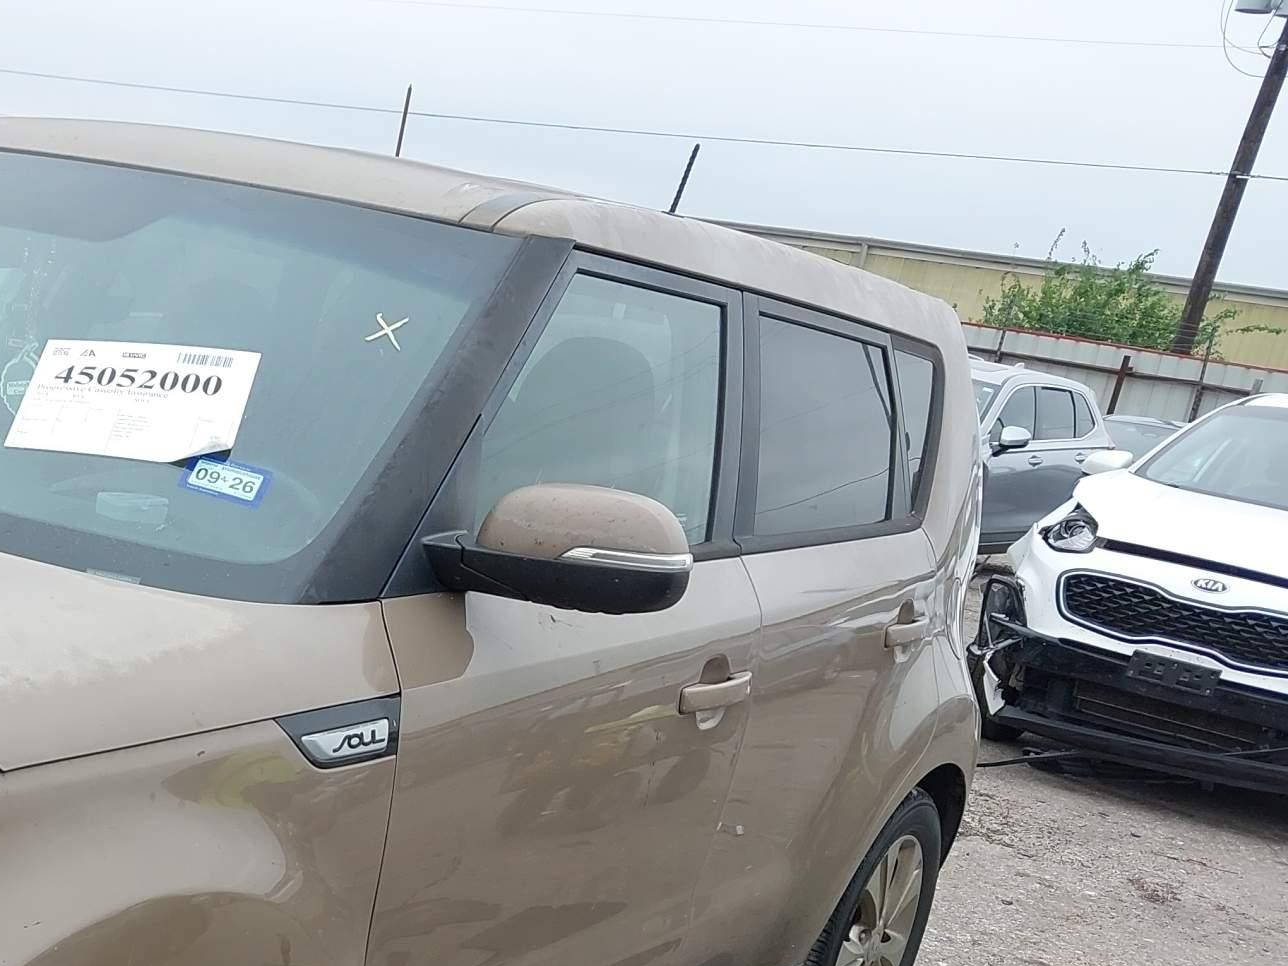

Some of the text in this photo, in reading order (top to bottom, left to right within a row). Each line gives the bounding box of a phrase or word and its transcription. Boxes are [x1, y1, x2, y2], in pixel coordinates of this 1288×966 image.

[54, 364, 223, 397] 45052000
[195, 467, 221, 484] 09
[228, 476, 256, 494] 26
[1196, 579, 1224, 592] KIA
[332, 729, 386, 753] SOUL
